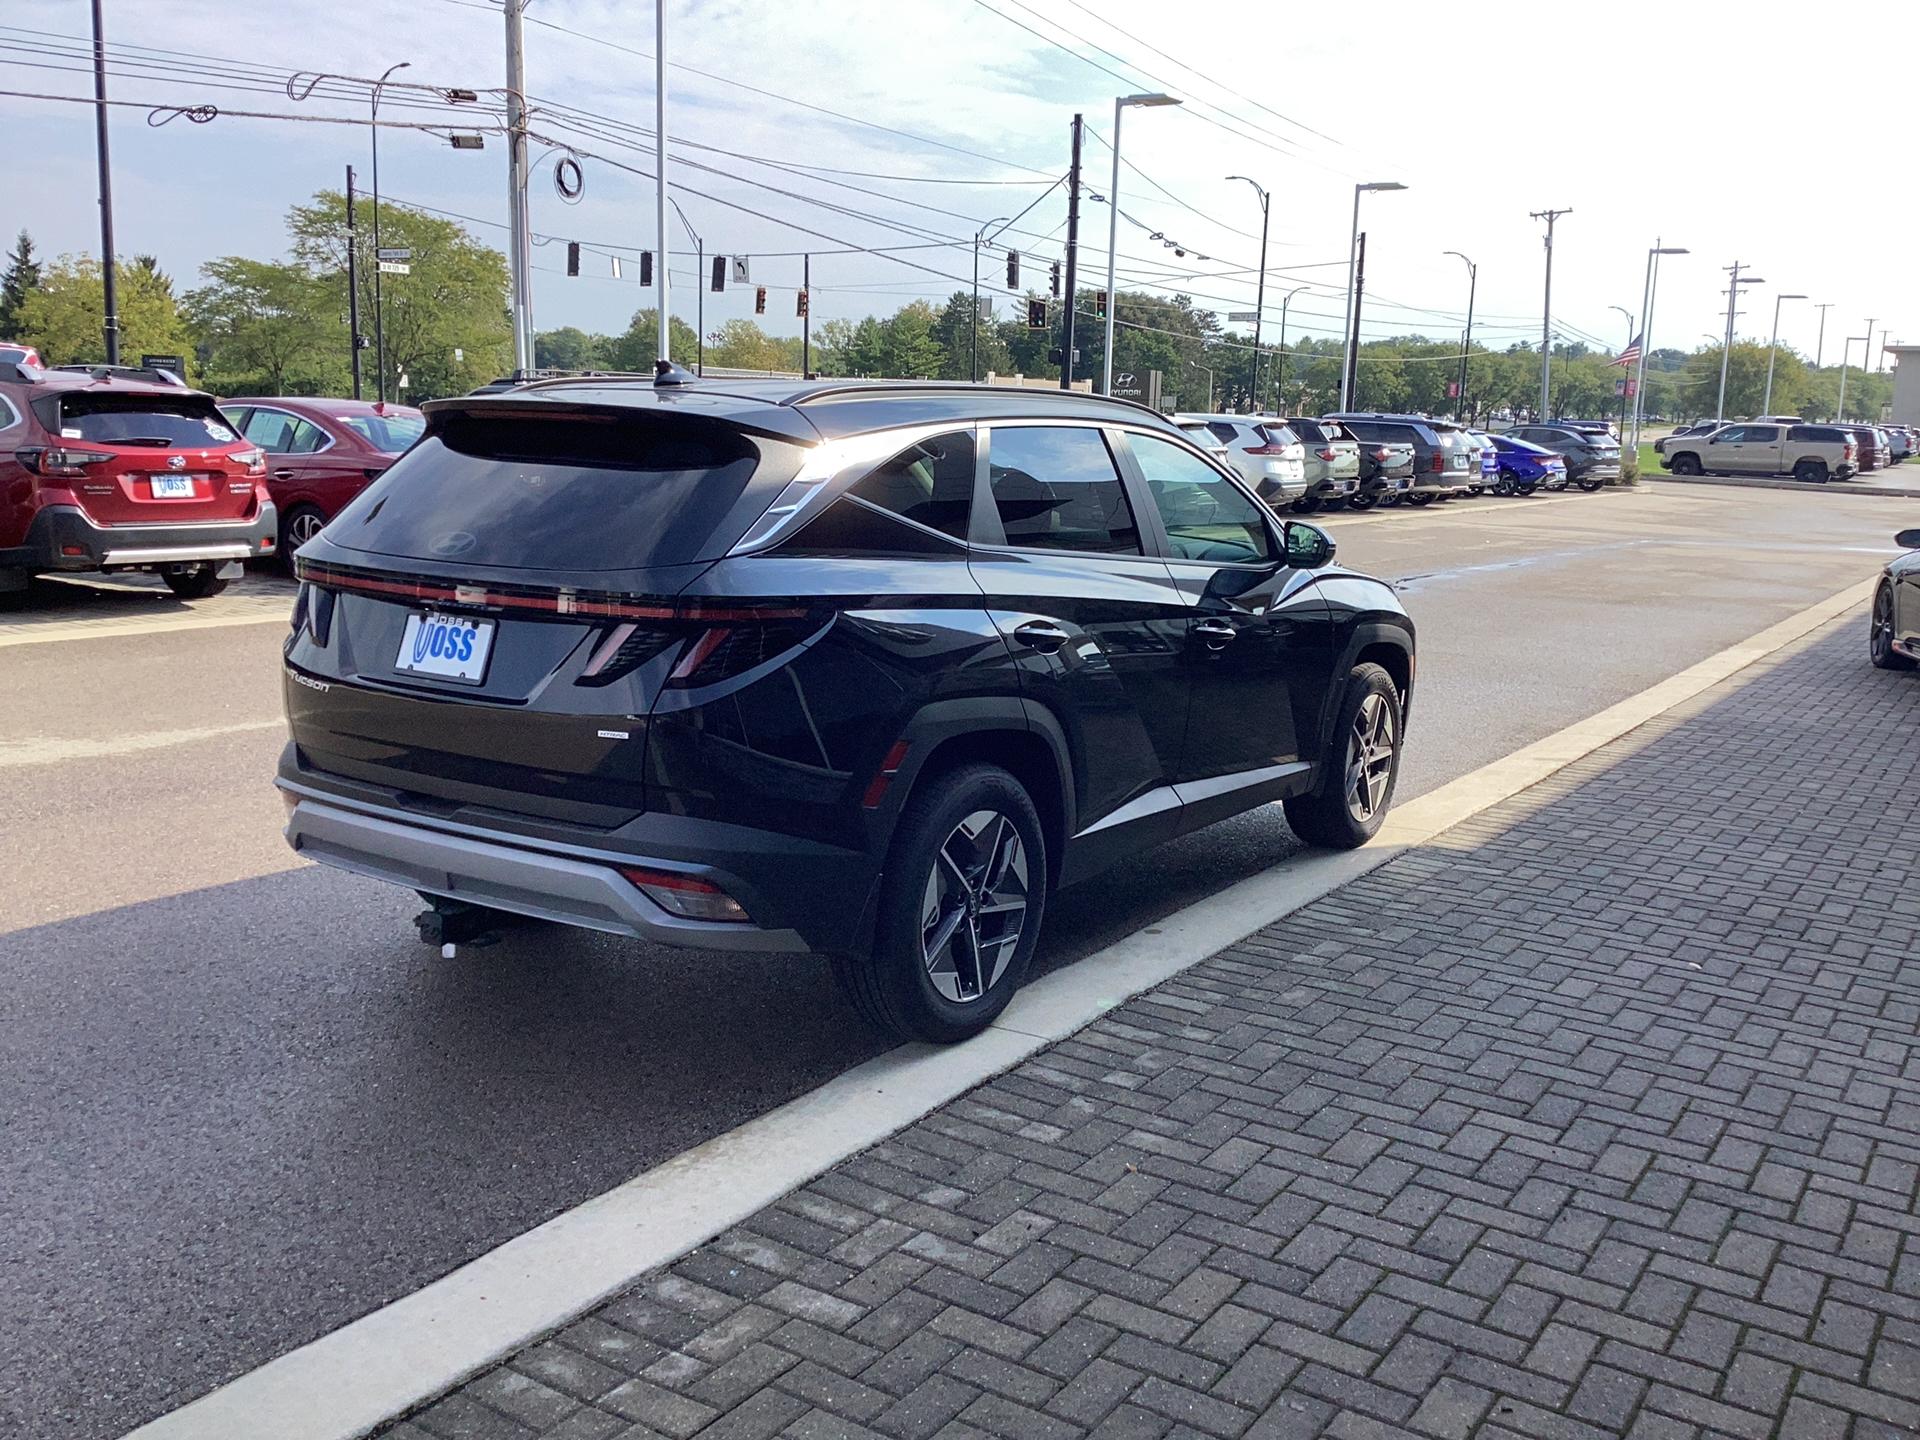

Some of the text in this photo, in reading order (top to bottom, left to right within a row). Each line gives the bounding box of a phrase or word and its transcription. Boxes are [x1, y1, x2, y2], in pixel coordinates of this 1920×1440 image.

[157, 477, 186, 494] VOSS
[413, 623, 477, 663] VOSS
[288, 668, 330, 693] TUCSON
